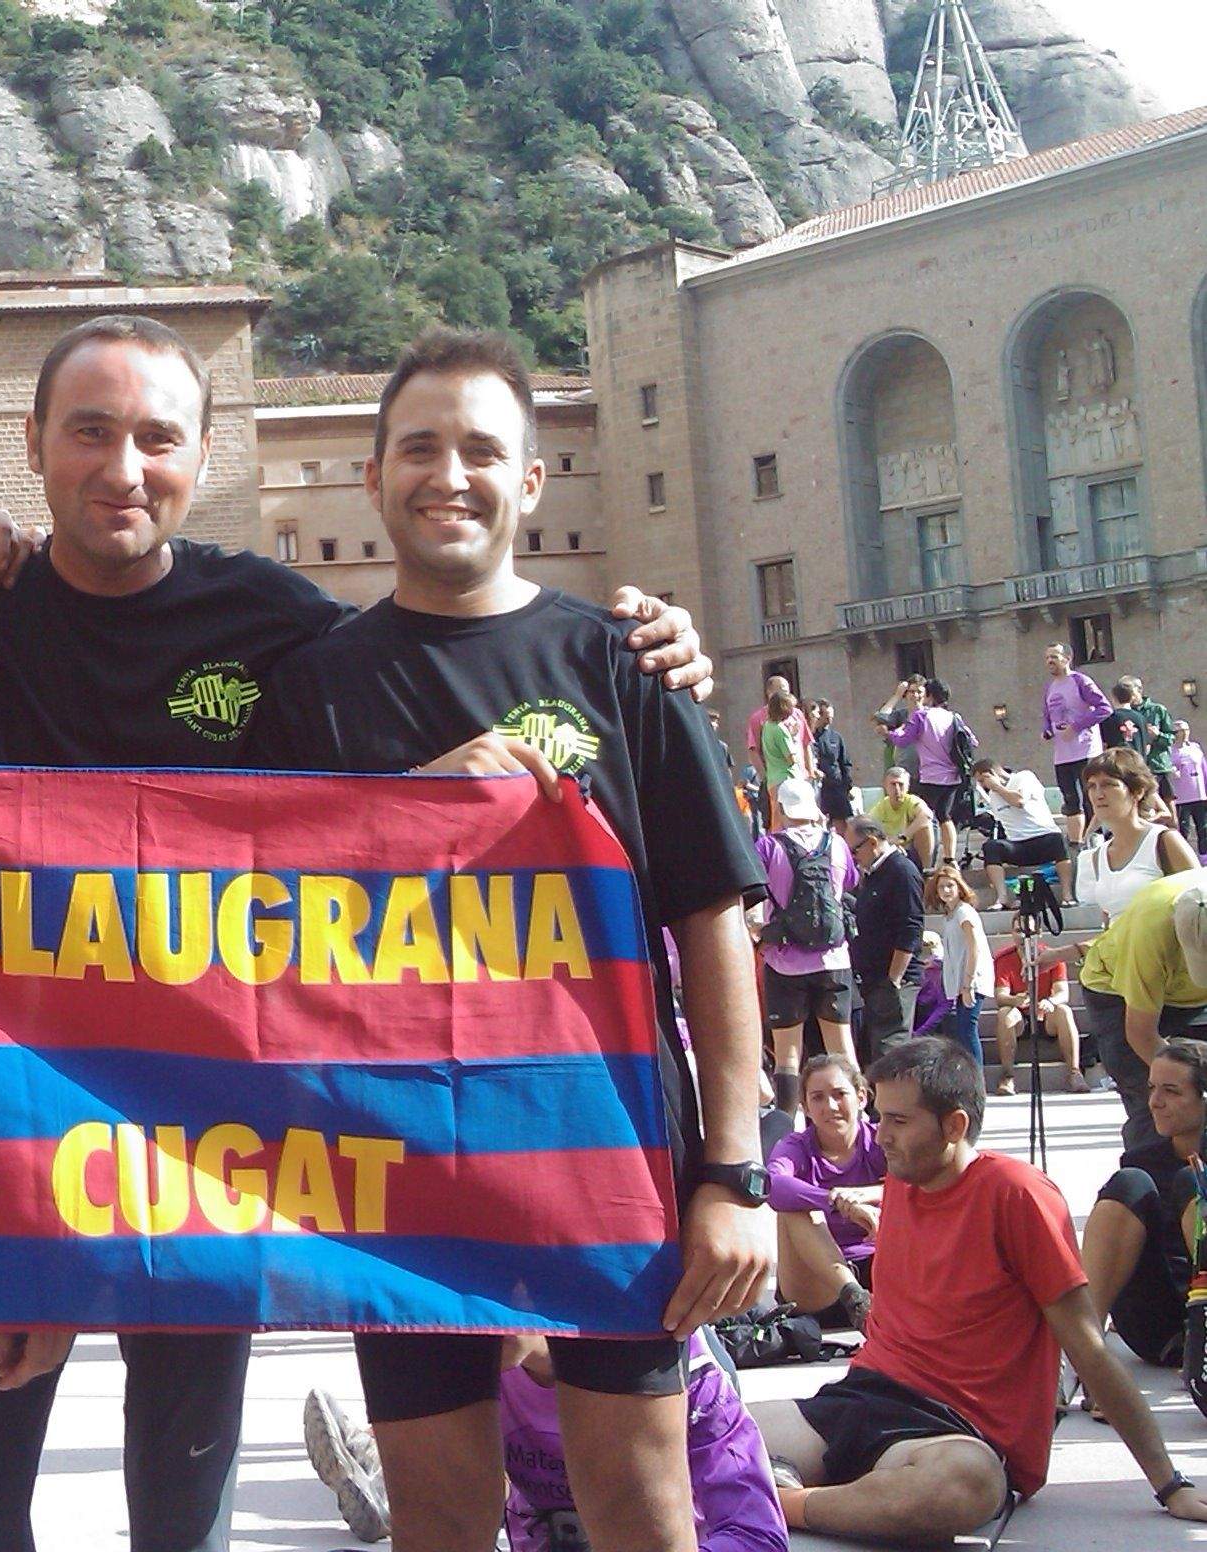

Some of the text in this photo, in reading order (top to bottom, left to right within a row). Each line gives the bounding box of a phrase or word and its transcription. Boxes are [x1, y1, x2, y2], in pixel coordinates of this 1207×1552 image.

[503, 699, 590, 732] PENYA BLAUGRANA
[51, 1121, 405, 1237] CUGAT
